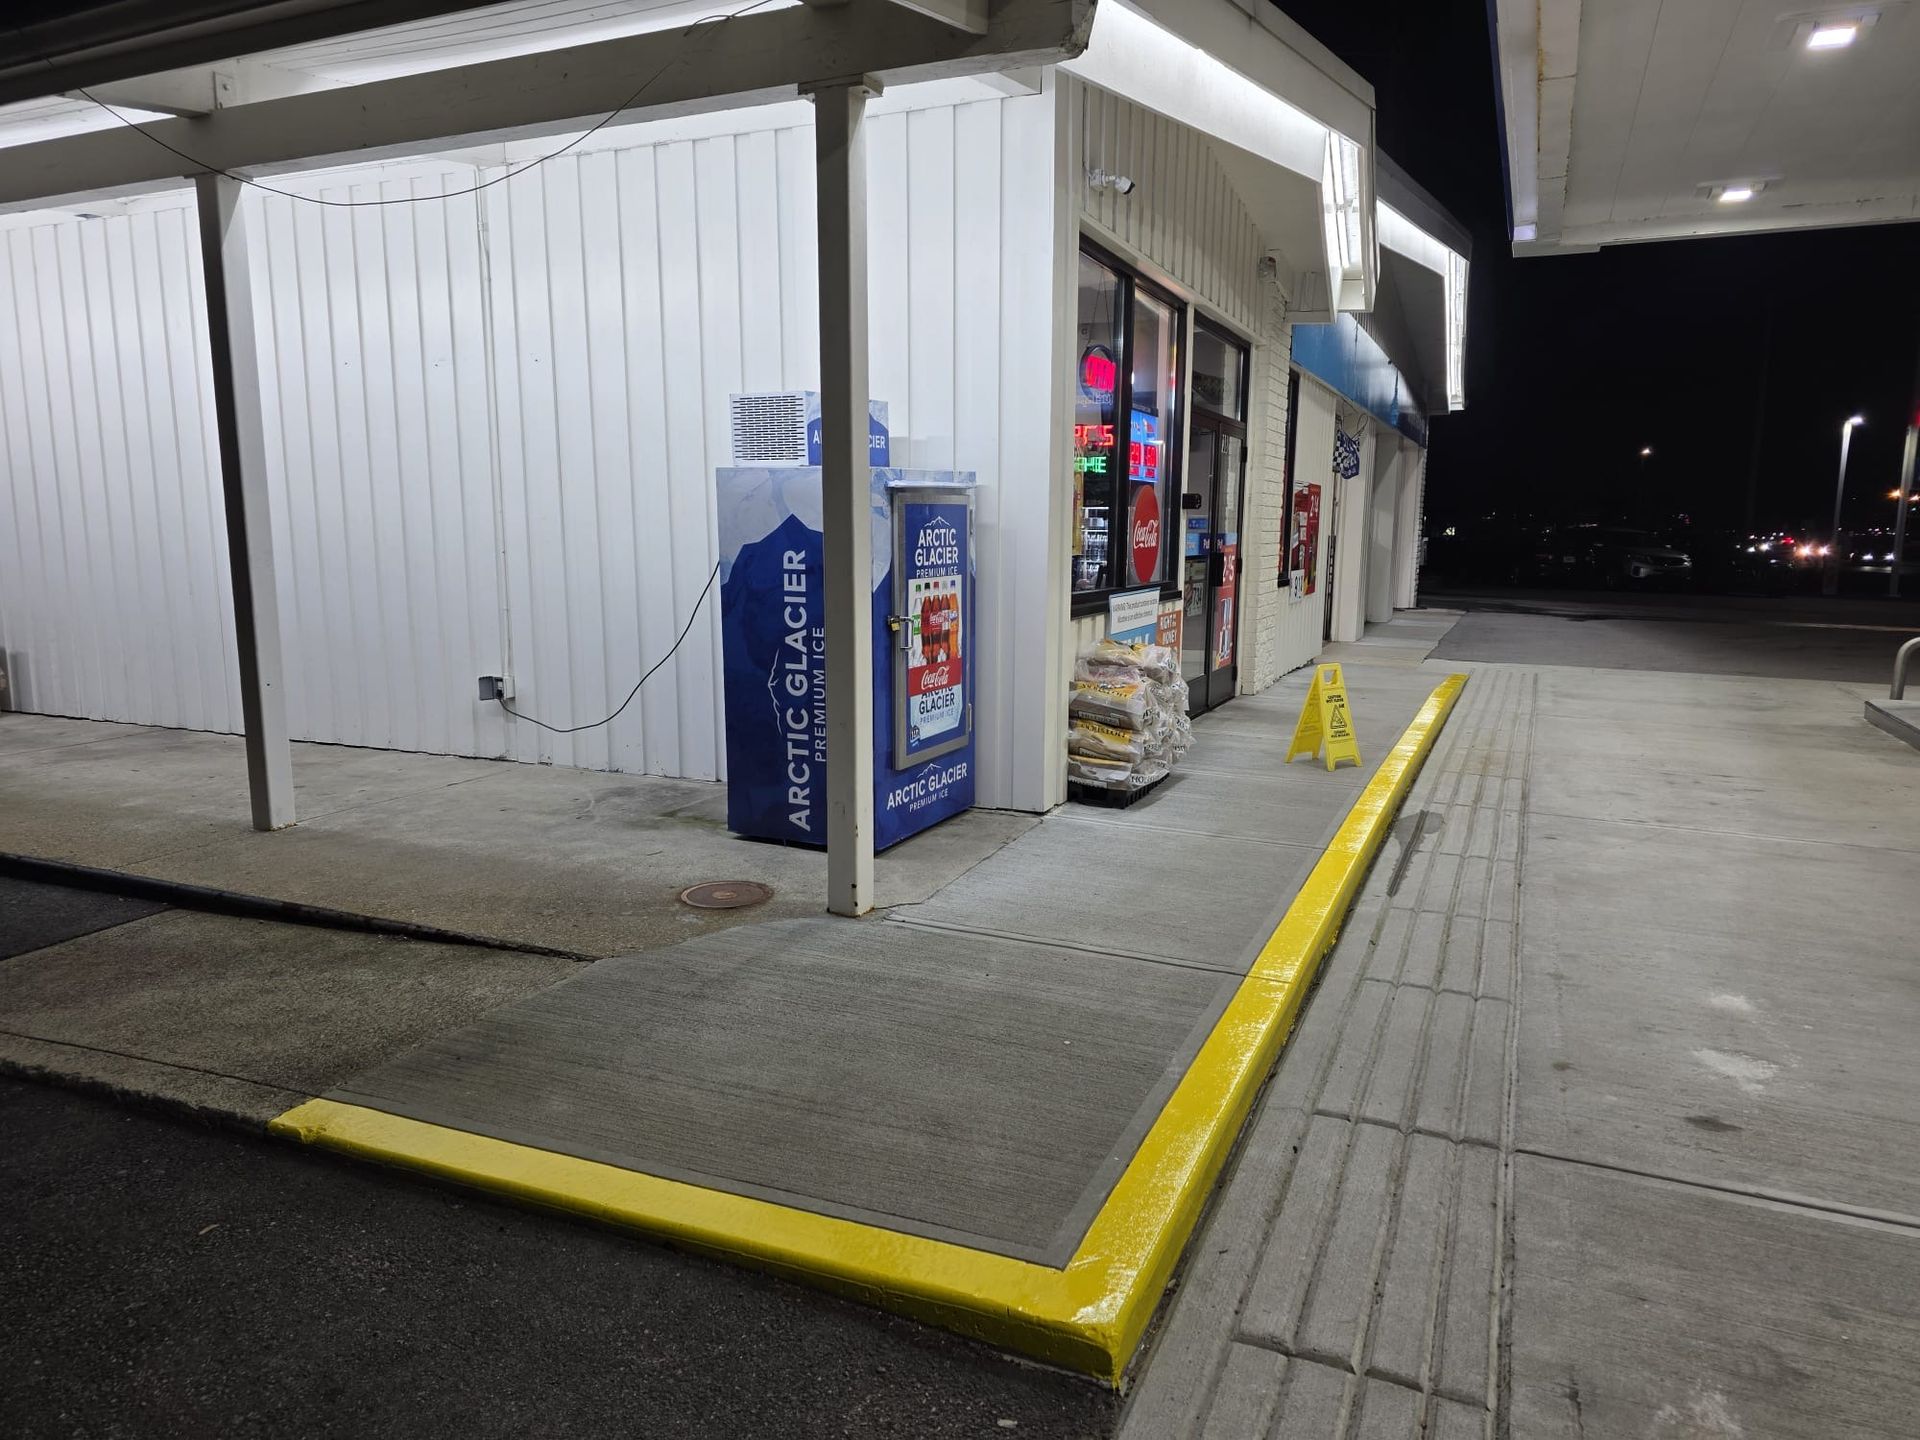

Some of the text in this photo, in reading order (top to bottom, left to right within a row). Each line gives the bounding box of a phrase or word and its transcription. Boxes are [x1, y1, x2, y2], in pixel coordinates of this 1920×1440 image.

[917, 528, 957, 547] ARCTIC
[914, 546, 959, 567] GLACIER
[916, 565, 958, 579] PREMIUM ICE
[783, 549, 811, 832] ARCTIC GLACIER
[812, 626, 827, 762] PREMIUM ICE
[918, 692, 955, 715] GLACIER
[919, 710, 944, 723] PREMIUM
[886, 762, 967, 811] ARCTIC GLACIER
[909, 788, 949, 813] PREMIUM ICE
